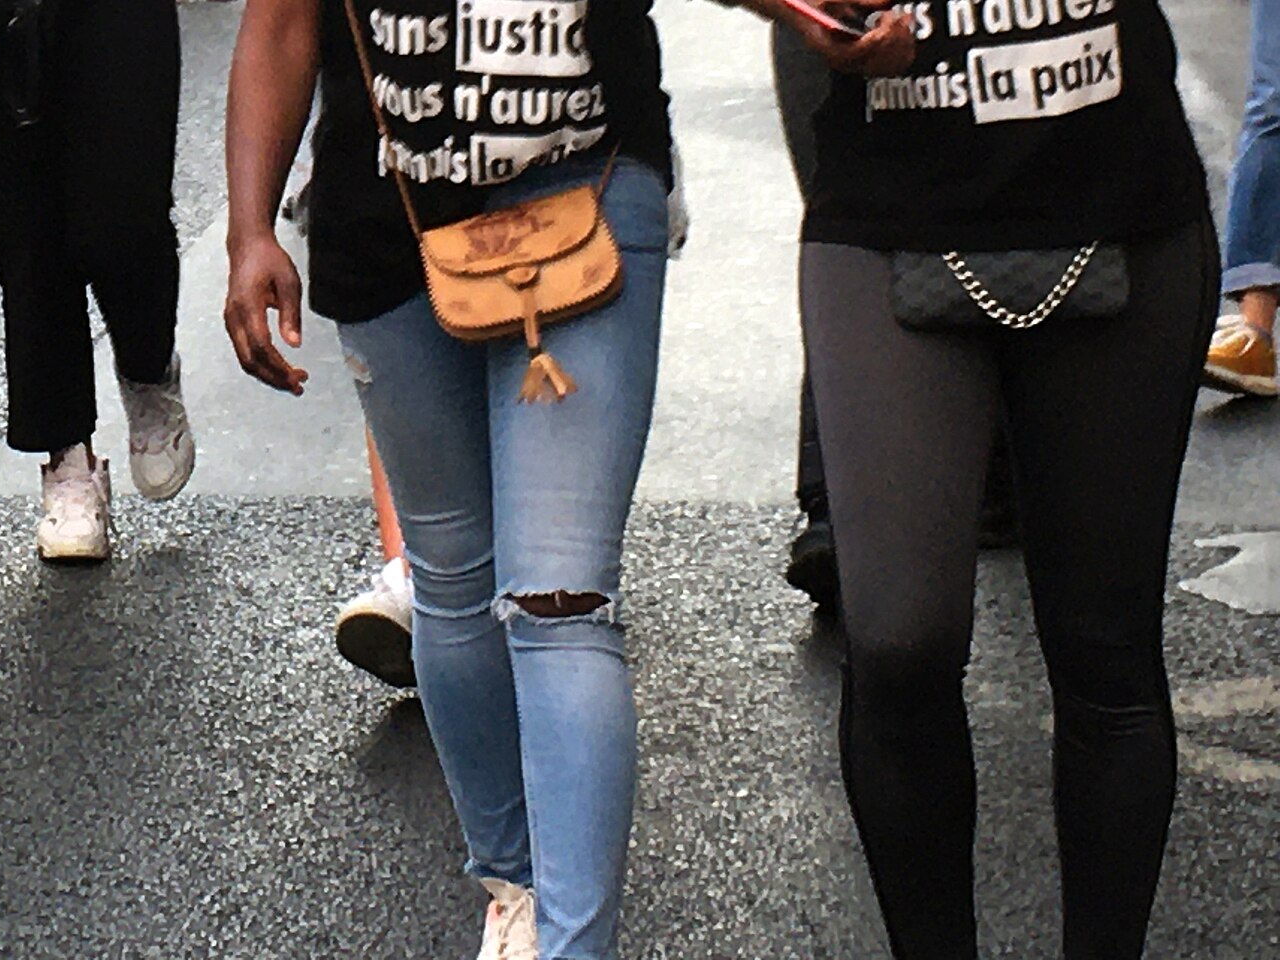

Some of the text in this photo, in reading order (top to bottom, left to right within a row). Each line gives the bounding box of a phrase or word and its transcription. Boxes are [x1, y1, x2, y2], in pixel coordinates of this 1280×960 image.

[460, 1, 587, 65] justic
[453, 73, 607, 126] n'aurez
[973, 54, 1017, 103] la
[1030, 42, 1115, 111] paix
[477, 141, 514, 182] la
